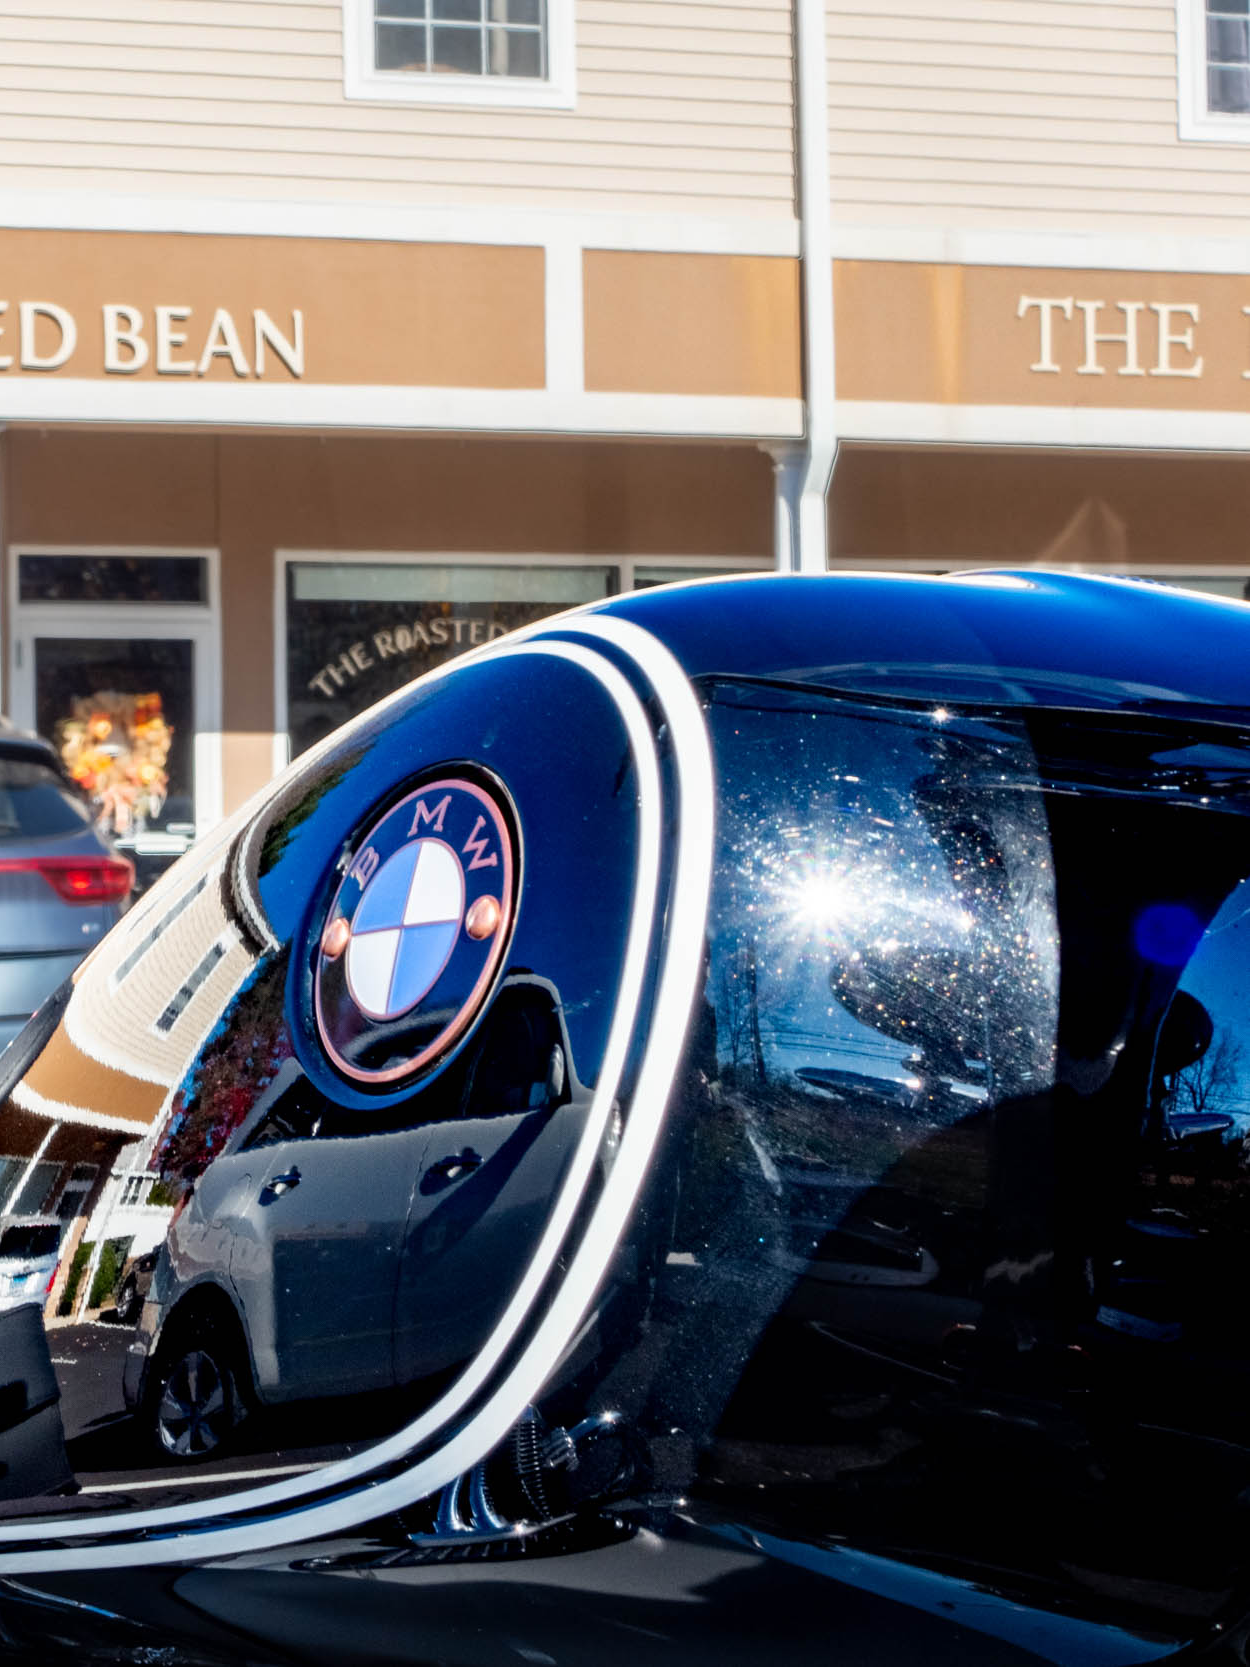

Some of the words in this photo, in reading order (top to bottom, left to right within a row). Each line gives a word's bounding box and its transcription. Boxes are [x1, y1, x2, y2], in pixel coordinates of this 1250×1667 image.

[102, 303, 305, 378] BEAN
[1017, 295, 1204, 379] THE
[308, 642, 374, 697] THE
[350, 795, 498, 892] BMW
